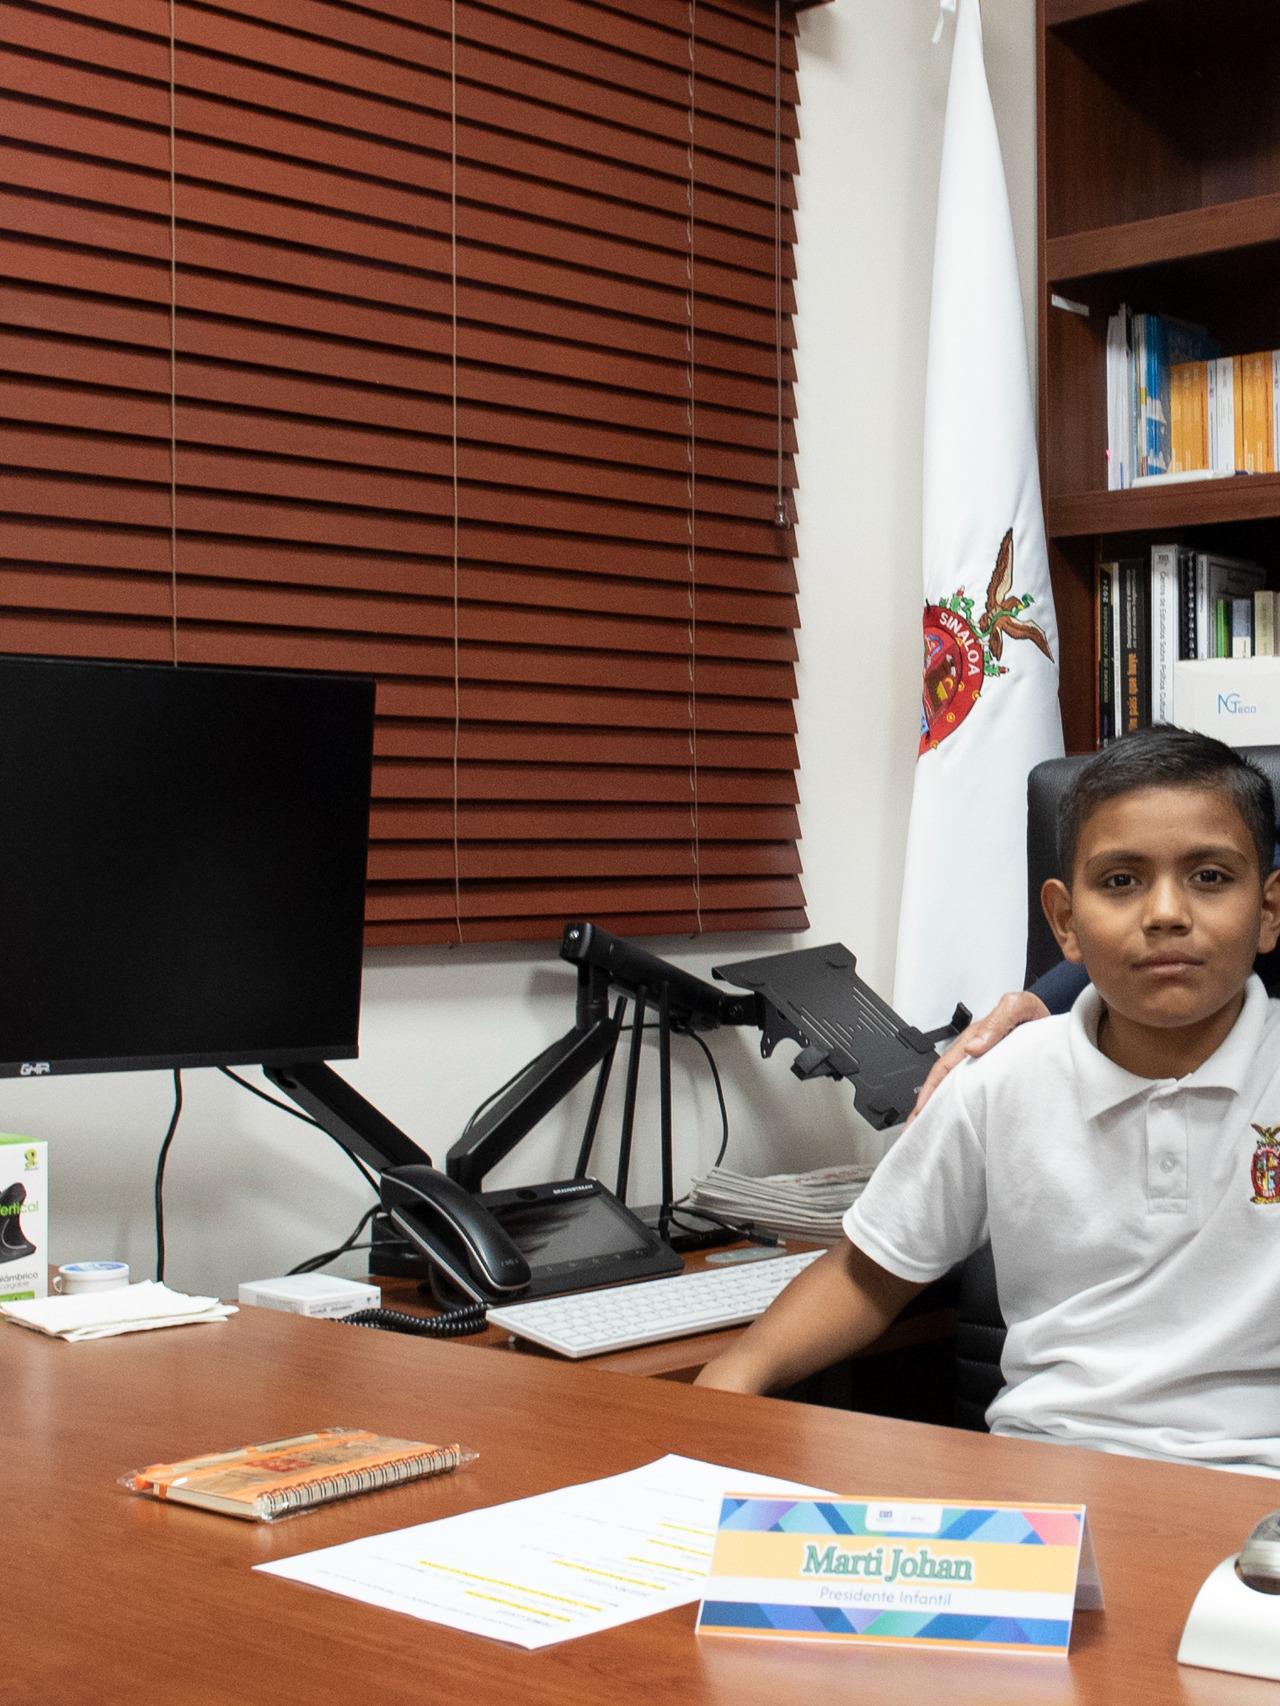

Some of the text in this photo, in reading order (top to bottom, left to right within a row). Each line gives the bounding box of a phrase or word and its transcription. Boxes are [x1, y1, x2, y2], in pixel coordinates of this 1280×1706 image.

[1159, 571, 1167, 596] Centro
[1159, 599, 1167, 607] de
[1159, 609, 1167, 639] Estudios
[939, 611, 981, 677] SINALOA
[1159, 641, 1167, 662] Sobre
[0, 1200, 39, 1216] ertical
[0, 1271, 39, 1283] lámbrico
[802, 1545, 973, 1583] Marti Johan
[819, 1586, 952, 1607] Presidente Infantil
